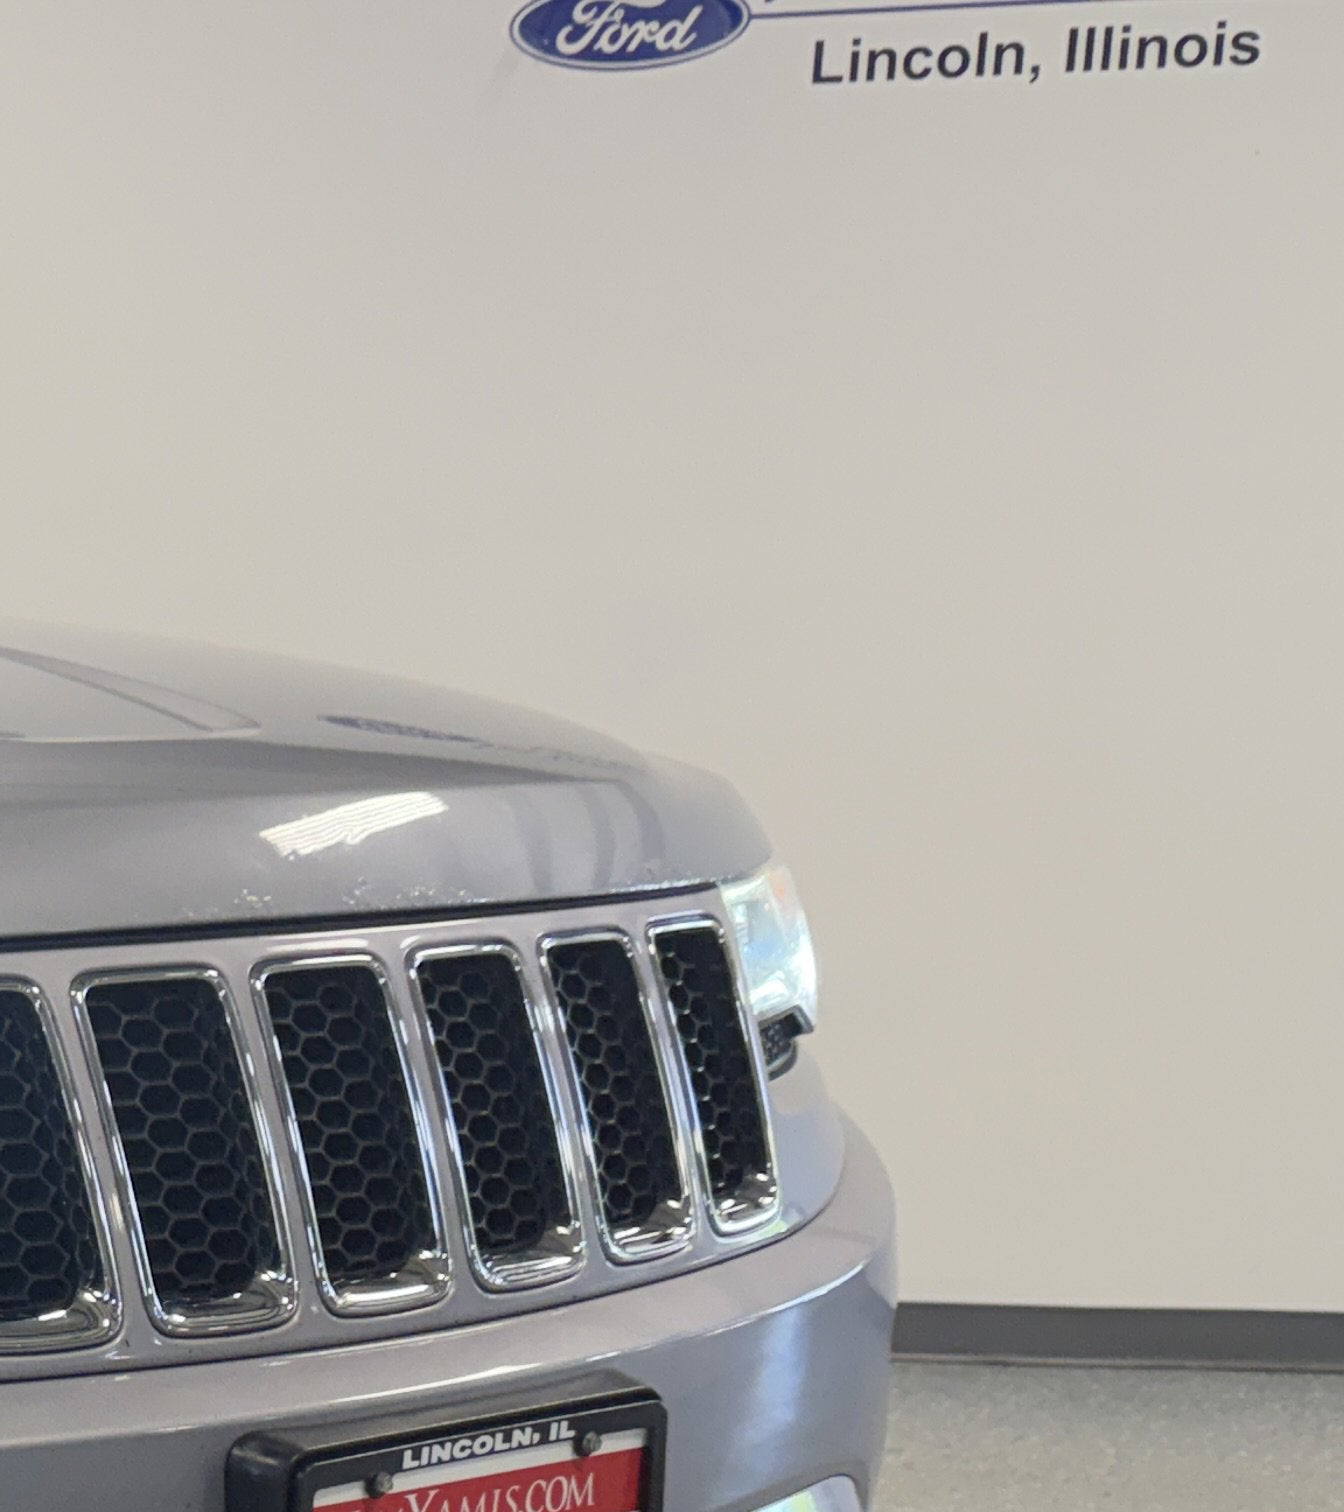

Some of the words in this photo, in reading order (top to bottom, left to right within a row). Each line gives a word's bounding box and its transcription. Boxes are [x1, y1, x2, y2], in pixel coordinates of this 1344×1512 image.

[555, 0, 704, 54] Ford
[812, 31, 1041, 85] Lincoln,
[1064, 20, 1262, 74] Illinois
[401, 1426, 541, 1471] LINCOLN,
[548, 1420, 577, 1442] IL
